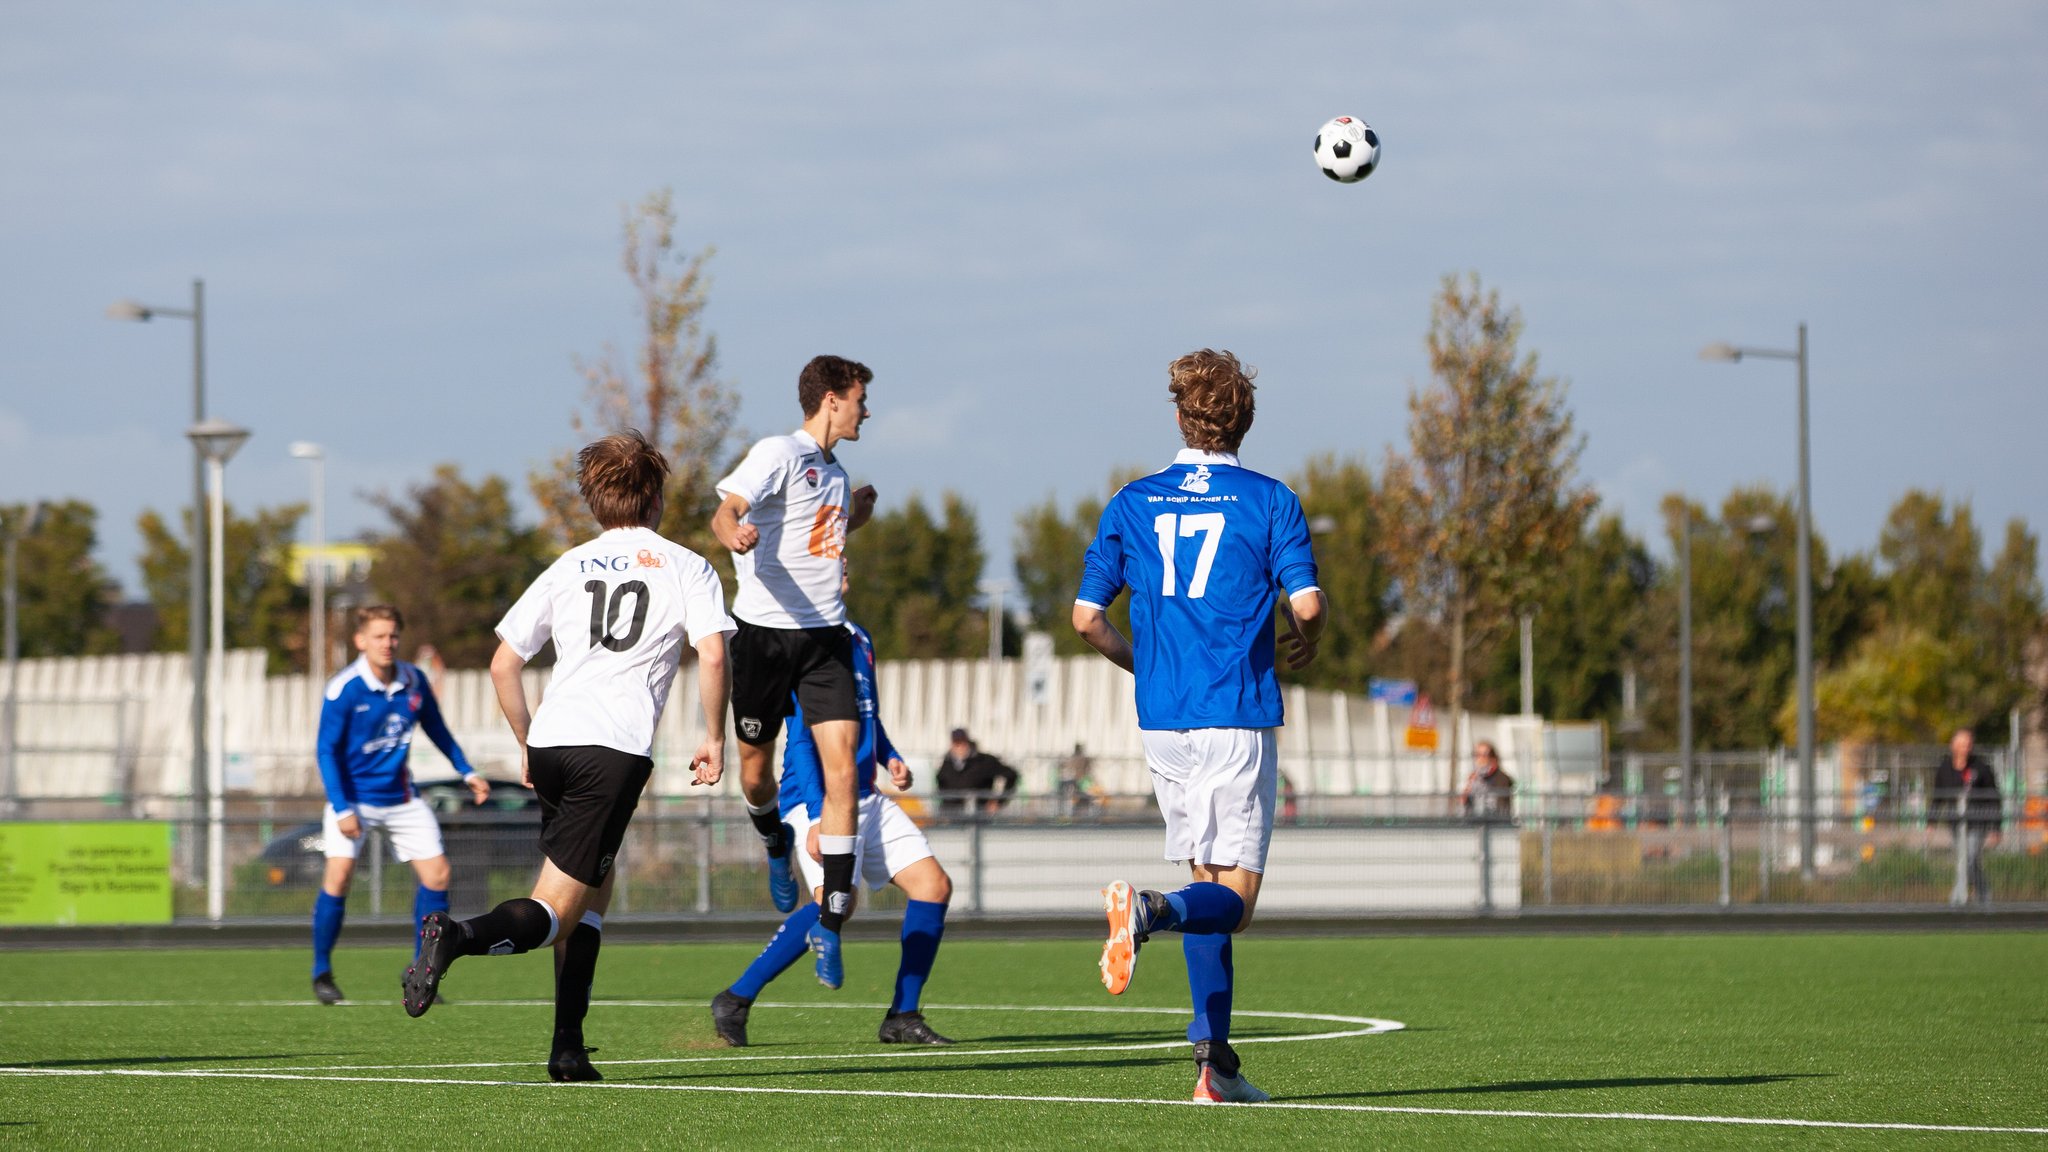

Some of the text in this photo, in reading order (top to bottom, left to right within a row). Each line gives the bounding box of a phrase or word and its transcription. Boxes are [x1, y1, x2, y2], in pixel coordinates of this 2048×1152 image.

[578, 555, 630, 574] ING
[1153, 512, 1226, 599] 17
[584, 579, 651, 653] 10
